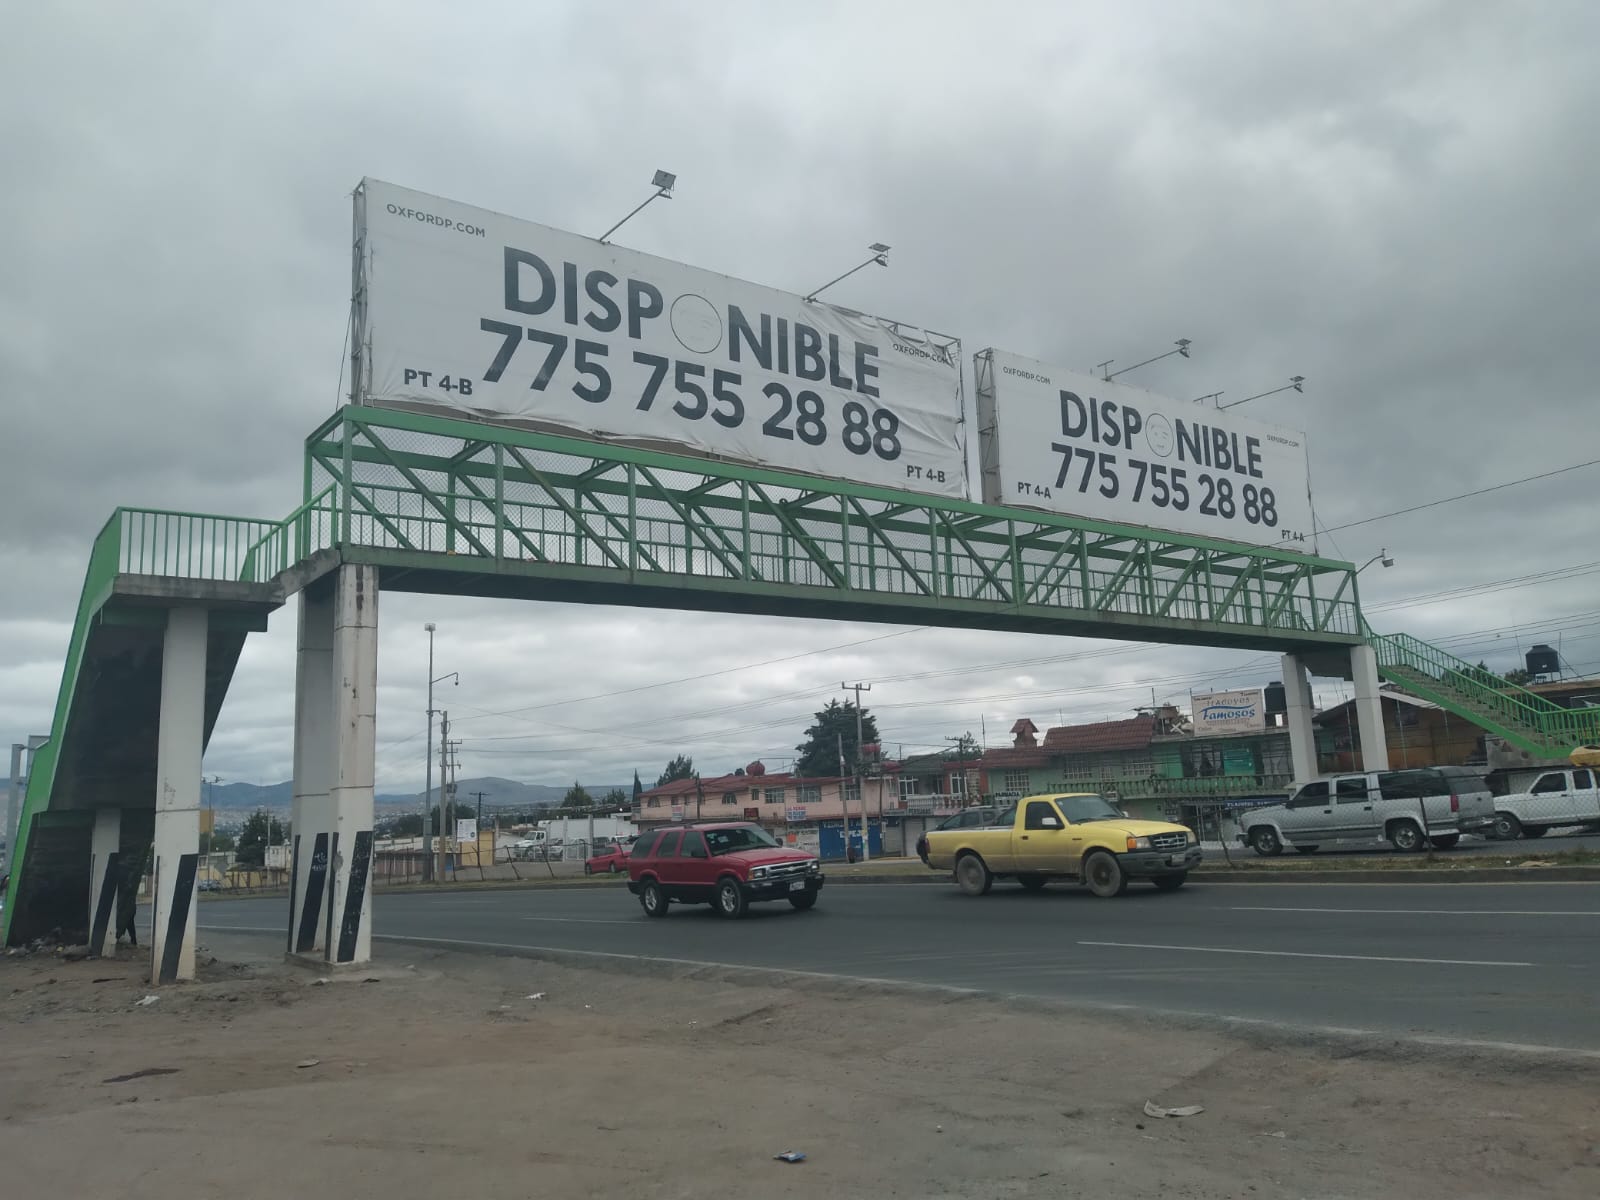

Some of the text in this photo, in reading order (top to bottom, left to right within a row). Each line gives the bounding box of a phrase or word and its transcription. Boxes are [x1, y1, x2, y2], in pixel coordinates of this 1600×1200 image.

[386, 203, 485, 238] OXFORDP.COM
[404, 368, 473, 396] PT 4-B
[1002, 366, 1051, 385] OXFORDP.COM
[480, 317, 902, 461] 775 755 28 88
[906, 464, 946, 483] PT 4-B
[1051, 442, 1279, 528] 775 755 28 88
[1017, 481, 1051, 500] PT 4-A
[1281, 529, 1305, 542] PT 4-A
